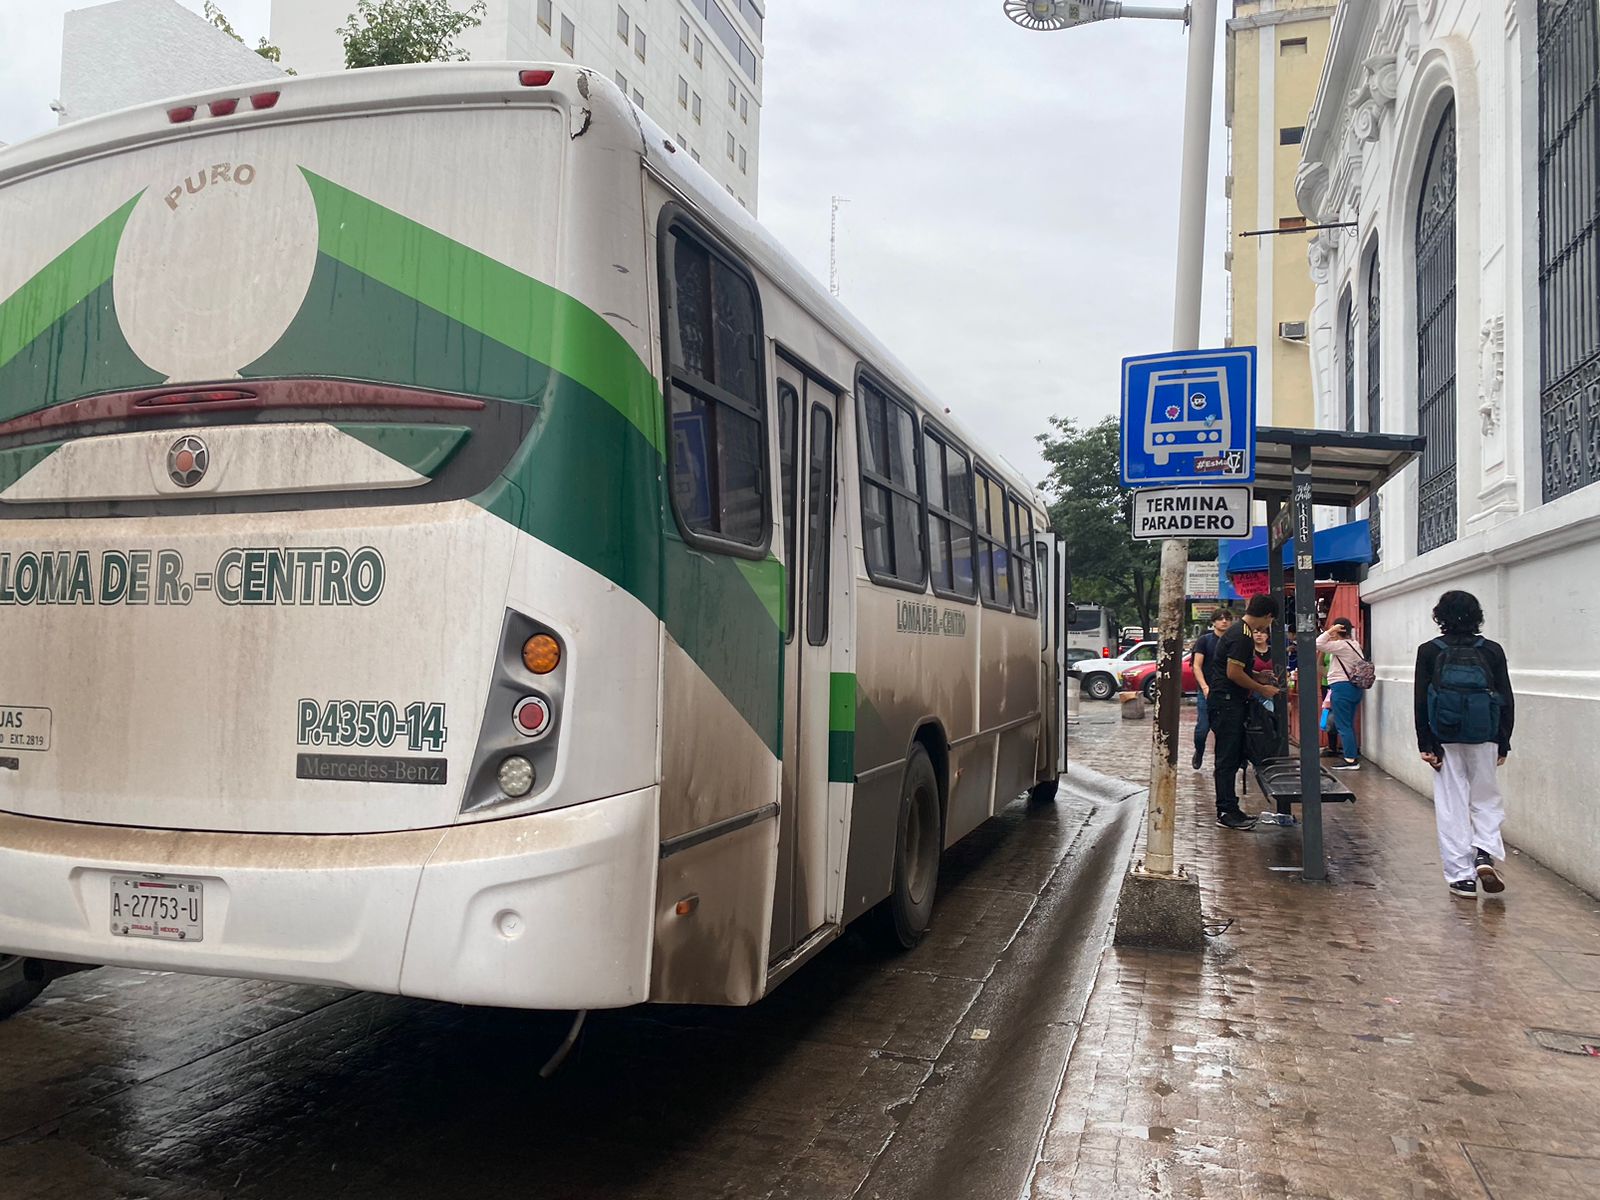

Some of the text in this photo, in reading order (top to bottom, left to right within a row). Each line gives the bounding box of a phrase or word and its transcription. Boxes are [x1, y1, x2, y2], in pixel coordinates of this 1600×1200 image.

[164, 163, 256, 211] PURO
[1147, 496, 1229, 512] TERMINA
[1142, 515, 1235, 531] PARADERO
[0, 550, 94, 605] LOMA
[99, 549, 151, 605] DE
[297, 698, 448, 752] P.4350-14
[10, 734, 25, 745] EXT.
[26, 735, 44, 746] 2819
[304, 757, 440, 781] Mercedes-Benz
[113, 893, 198, 922] A-27753-U
